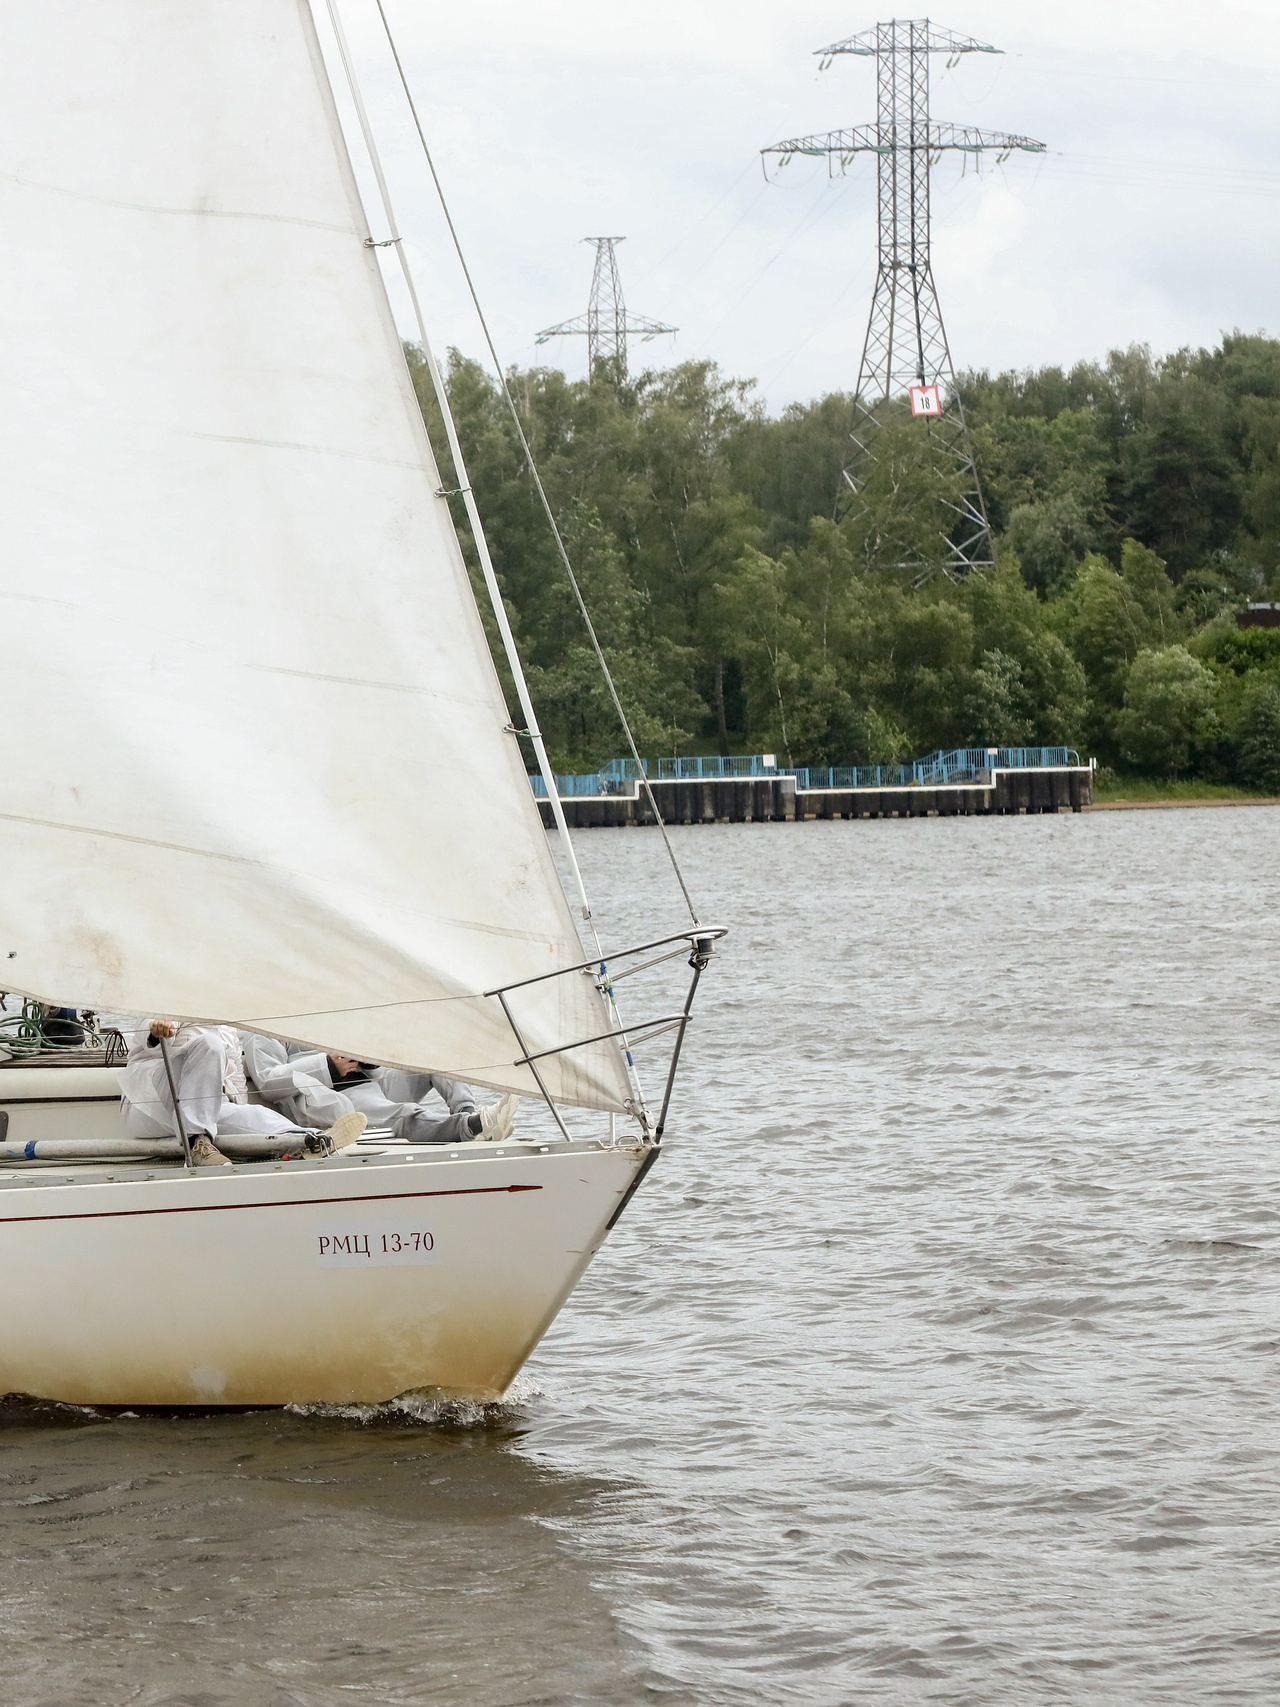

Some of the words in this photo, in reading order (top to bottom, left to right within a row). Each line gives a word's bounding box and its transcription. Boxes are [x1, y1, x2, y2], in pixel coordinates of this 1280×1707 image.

[920, 396, 931, 410] 18
[318, 1234, 371, 1258] РМЦ
[380, 1231, 435, 1253] 13-70
